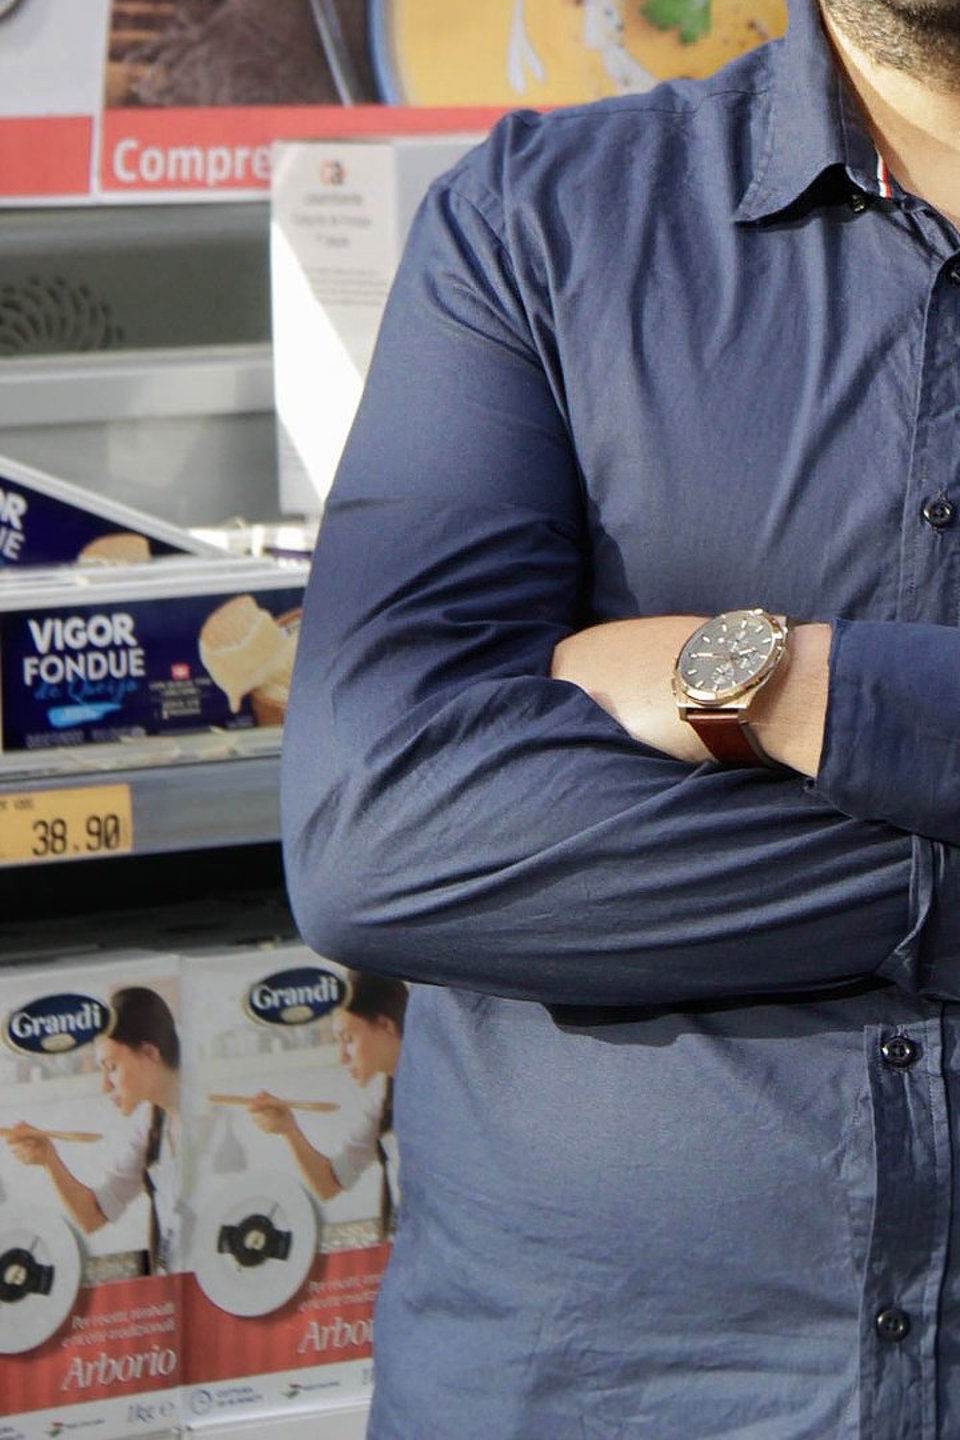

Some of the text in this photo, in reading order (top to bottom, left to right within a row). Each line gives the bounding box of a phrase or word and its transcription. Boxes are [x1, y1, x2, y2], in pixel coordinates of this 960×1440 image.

[28, 612, 138, 655] VIGOR
[23, 648, 146, 687] FONDUE
[32, 813, 120, 857] 38.90
[252, 975, 339, 1010] Grandi
[11, 1002, 101, 1039] Grandi
[61, 1344, 177, 1392] Arborio
